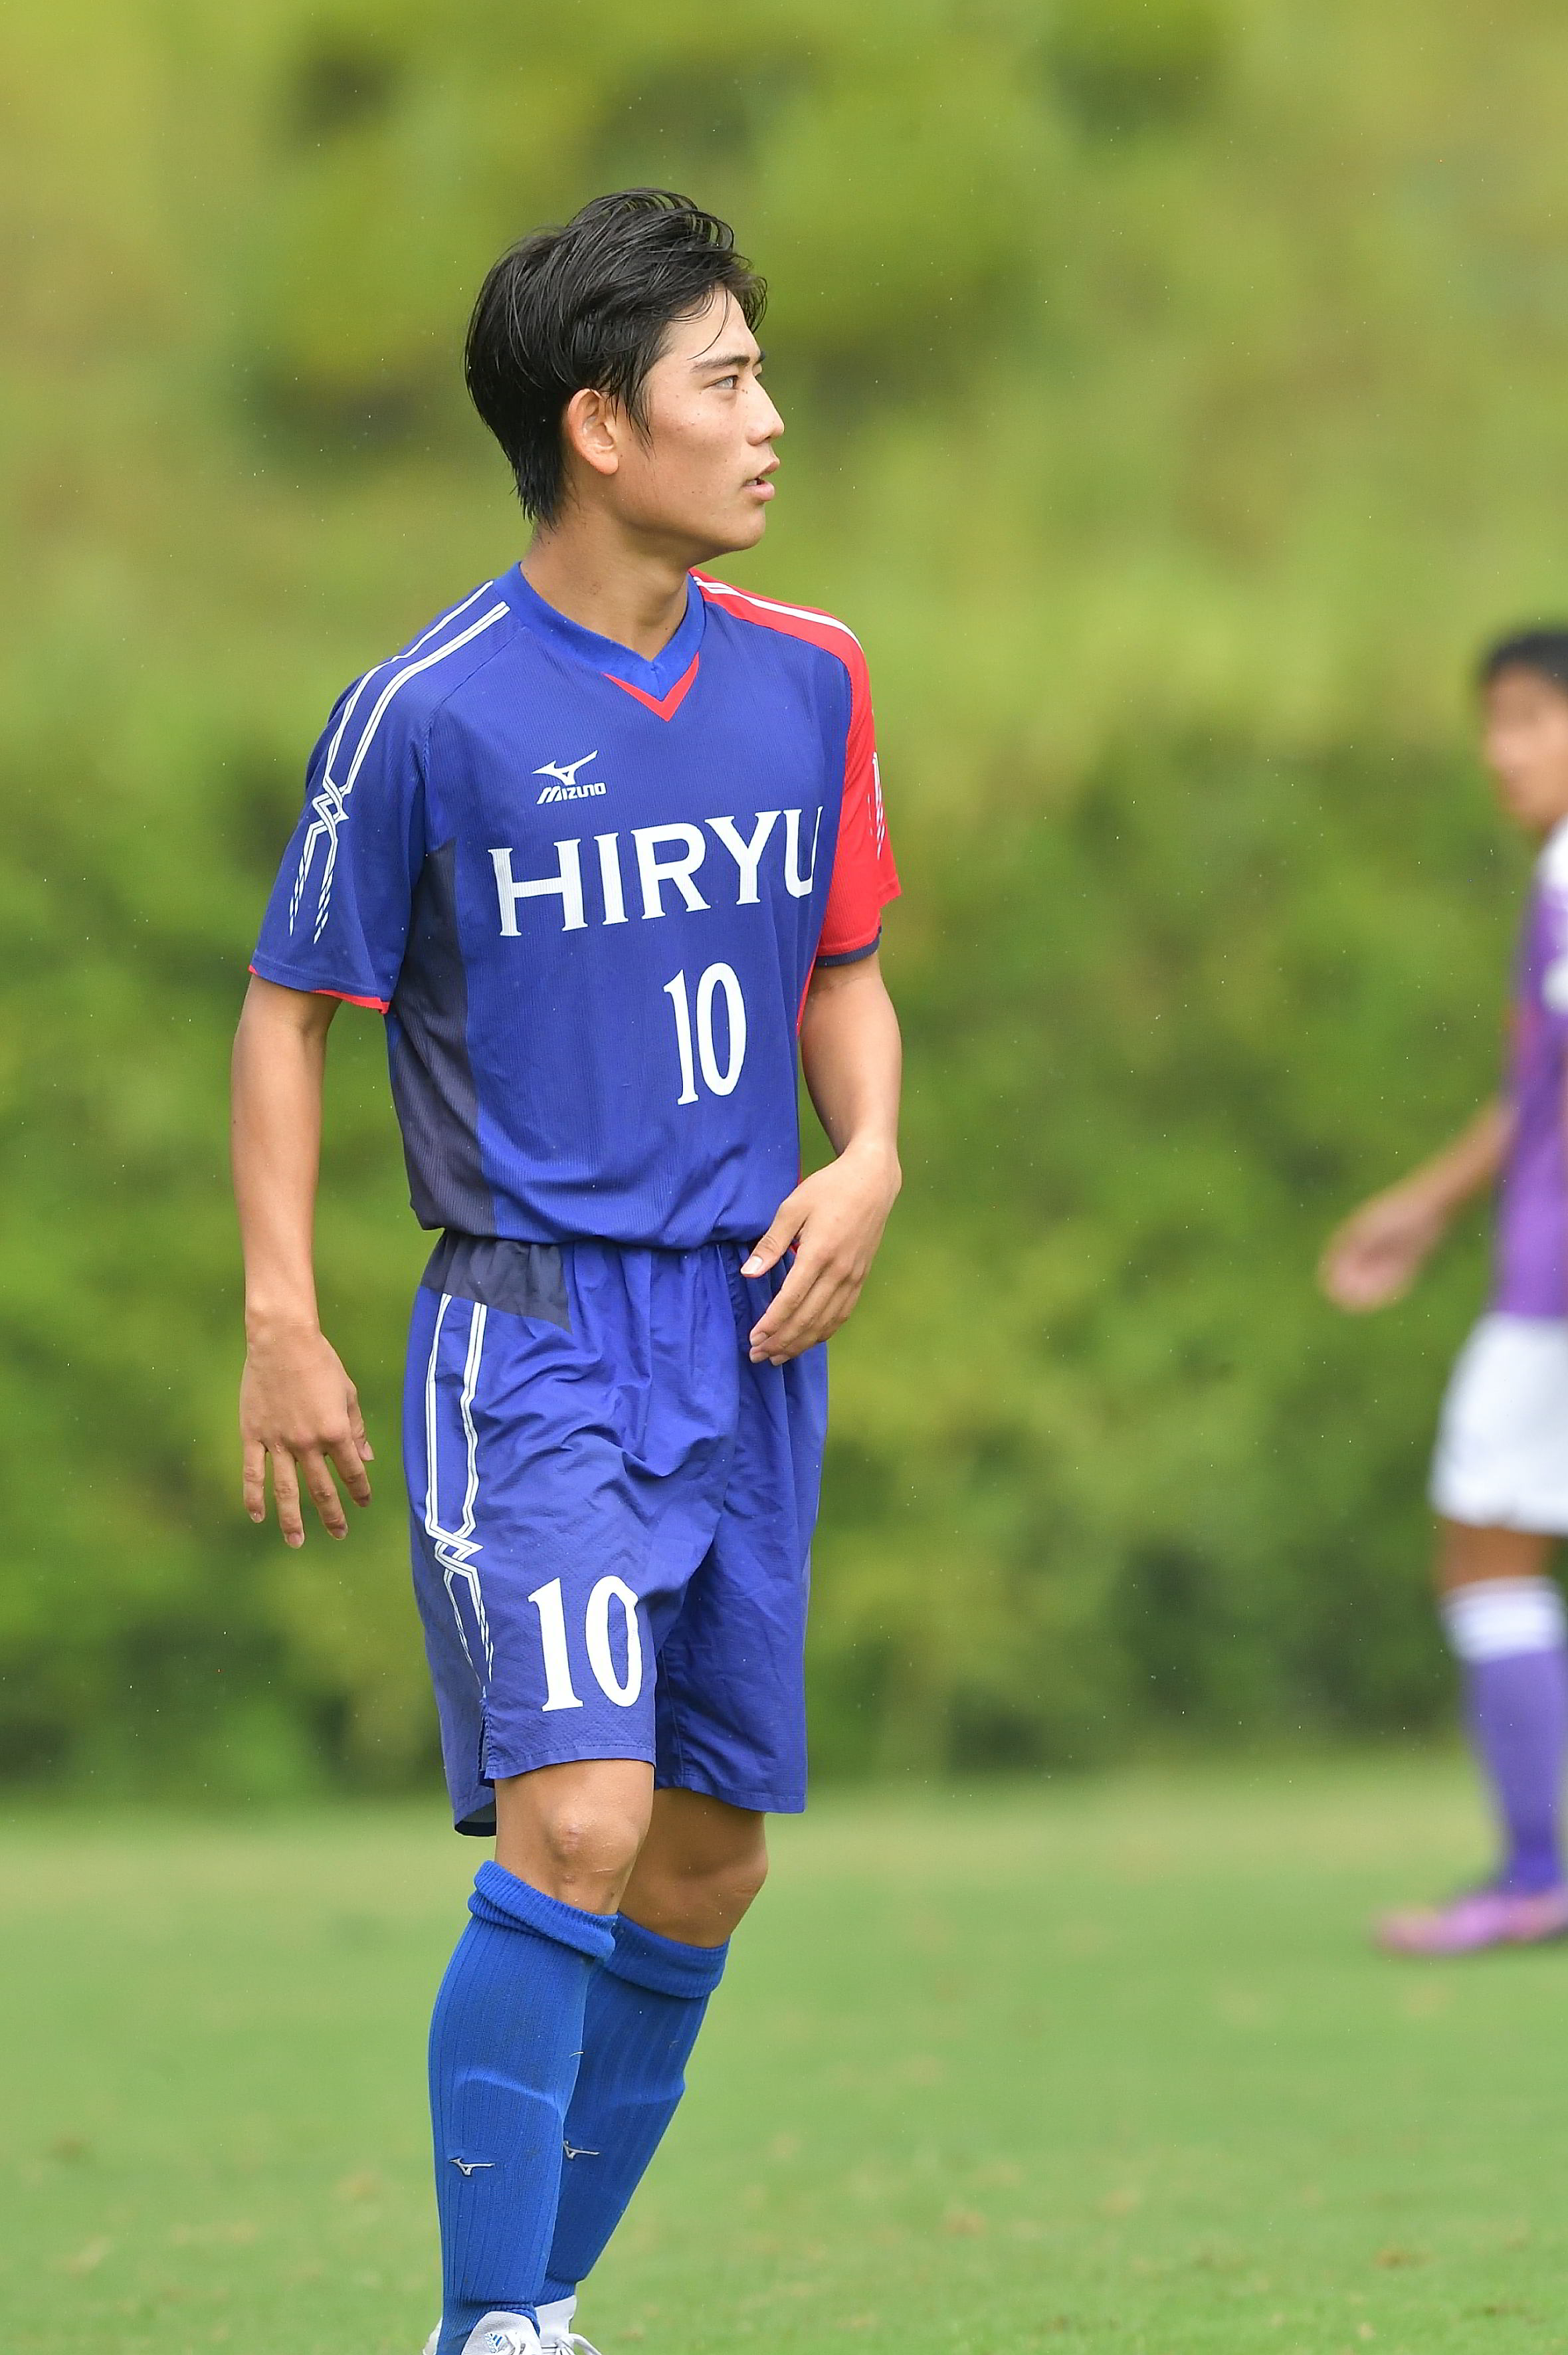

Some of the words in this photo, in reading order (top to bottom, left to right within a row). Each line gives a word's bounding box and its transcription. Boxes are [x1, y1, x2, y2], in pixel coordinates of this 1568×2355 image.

[488, 805, 823, 936] HIRYU
[663, 962, 747, 1105] 10
[528, 1575, 642, 1712] 10
